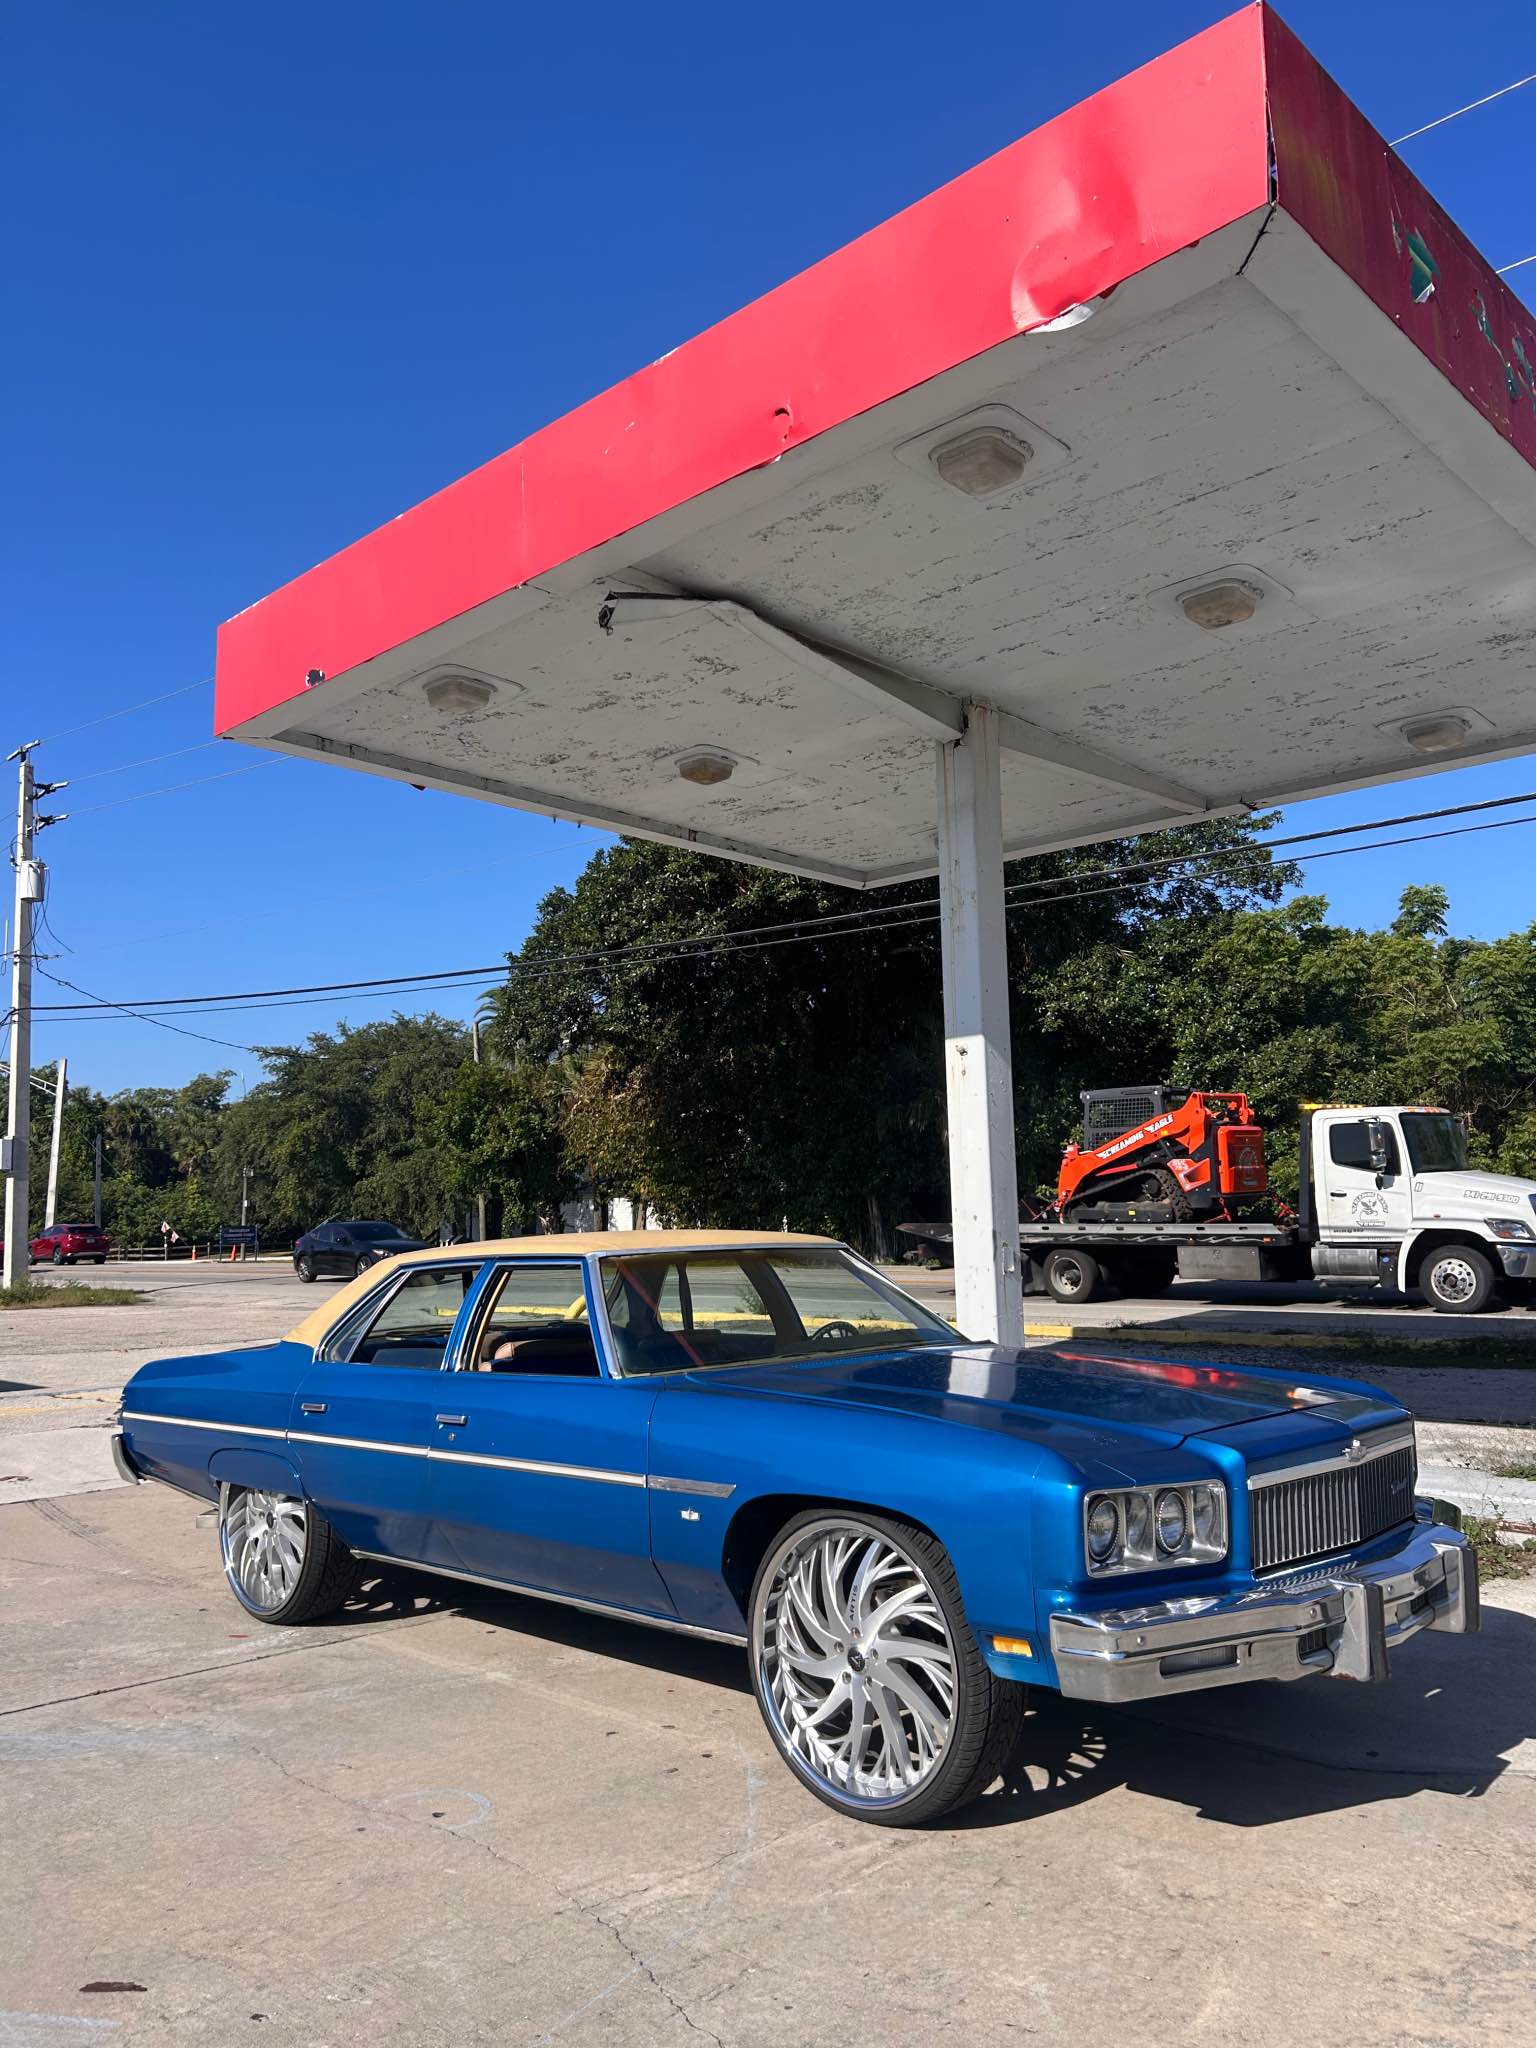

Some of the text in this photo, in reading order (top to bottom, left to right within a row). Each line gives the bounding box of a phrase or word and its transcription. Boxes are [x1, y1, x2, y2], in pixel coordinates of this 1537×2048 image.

[1095, 1113, 1174, 1159] SCREAMING EAGLE
[849, 1584, 858, 1621] ARTIS
